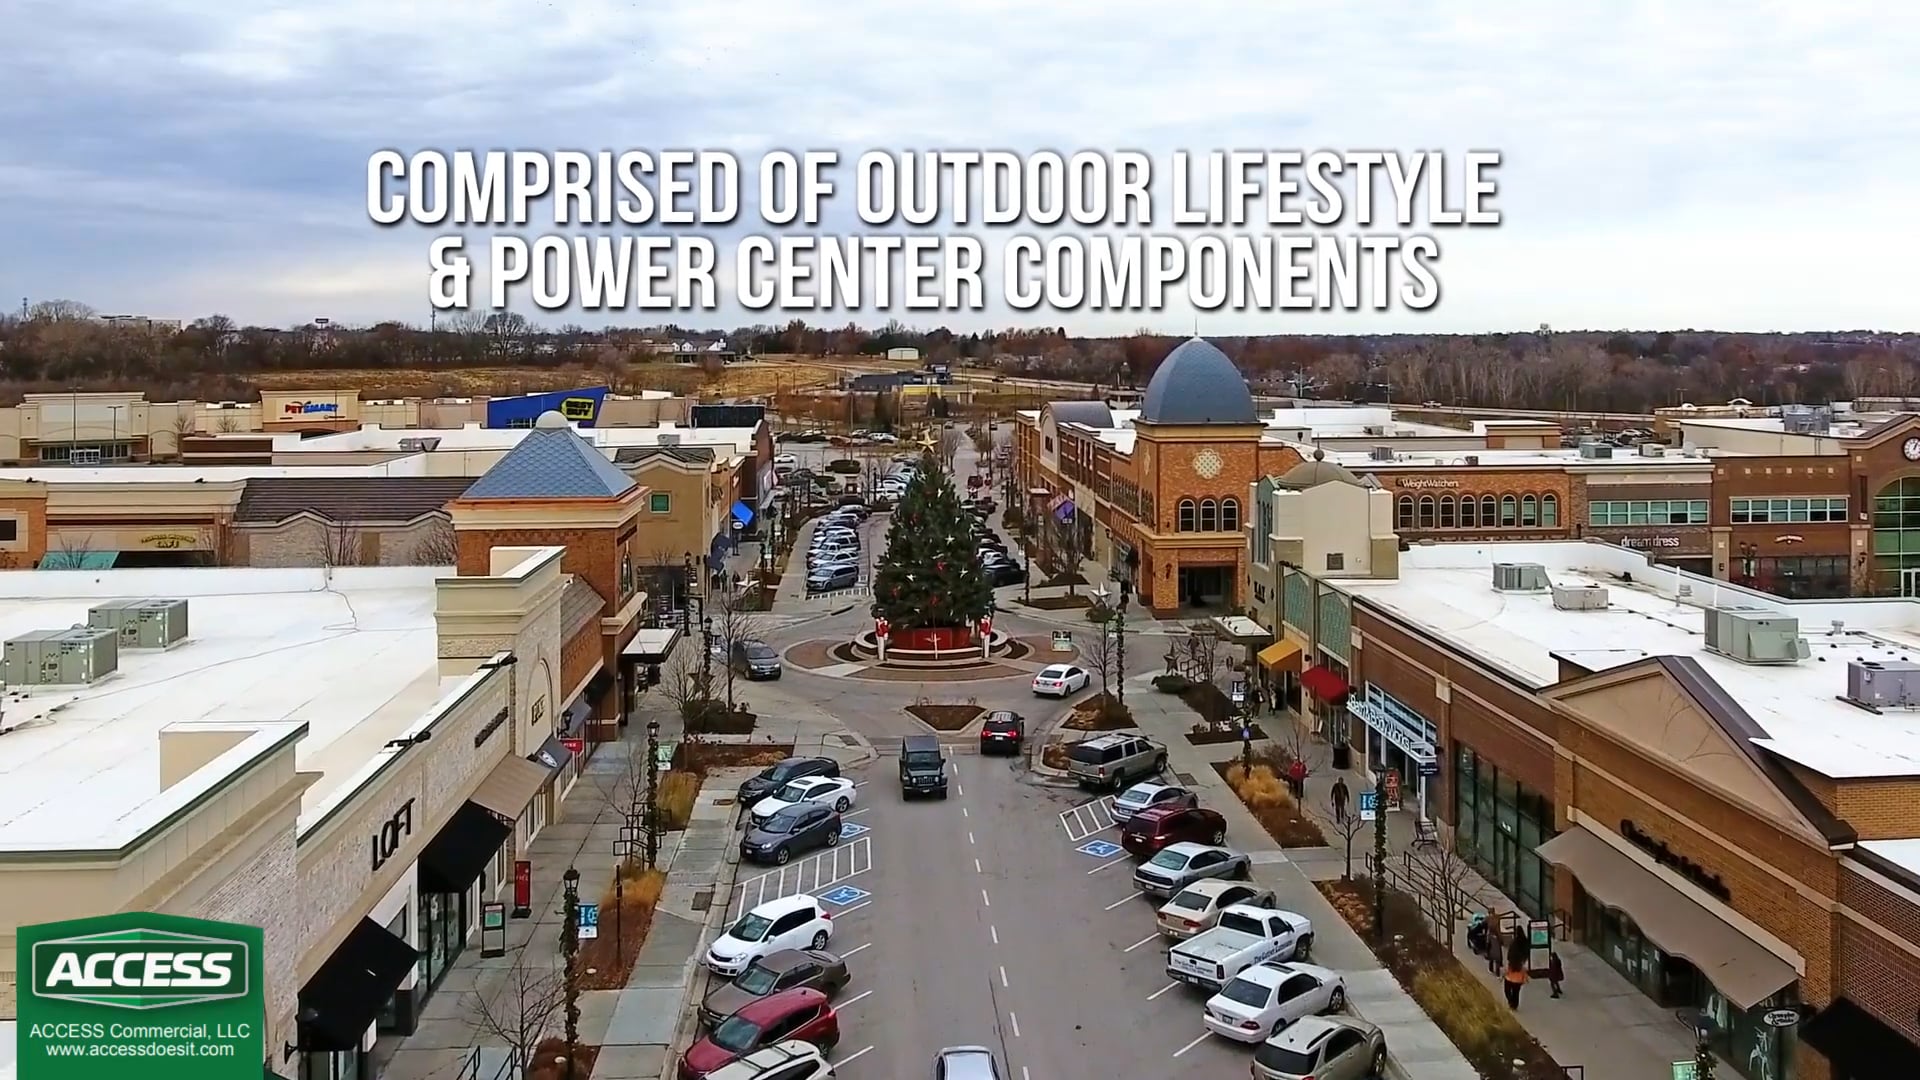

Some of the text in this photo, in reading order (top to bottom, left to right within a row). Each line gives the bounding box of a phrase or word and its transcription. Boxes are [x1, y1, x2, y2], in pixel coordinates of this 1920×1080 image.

[1621, 535, 1680, 548] dream dress
[372, 798, 415, 871] LOFT
